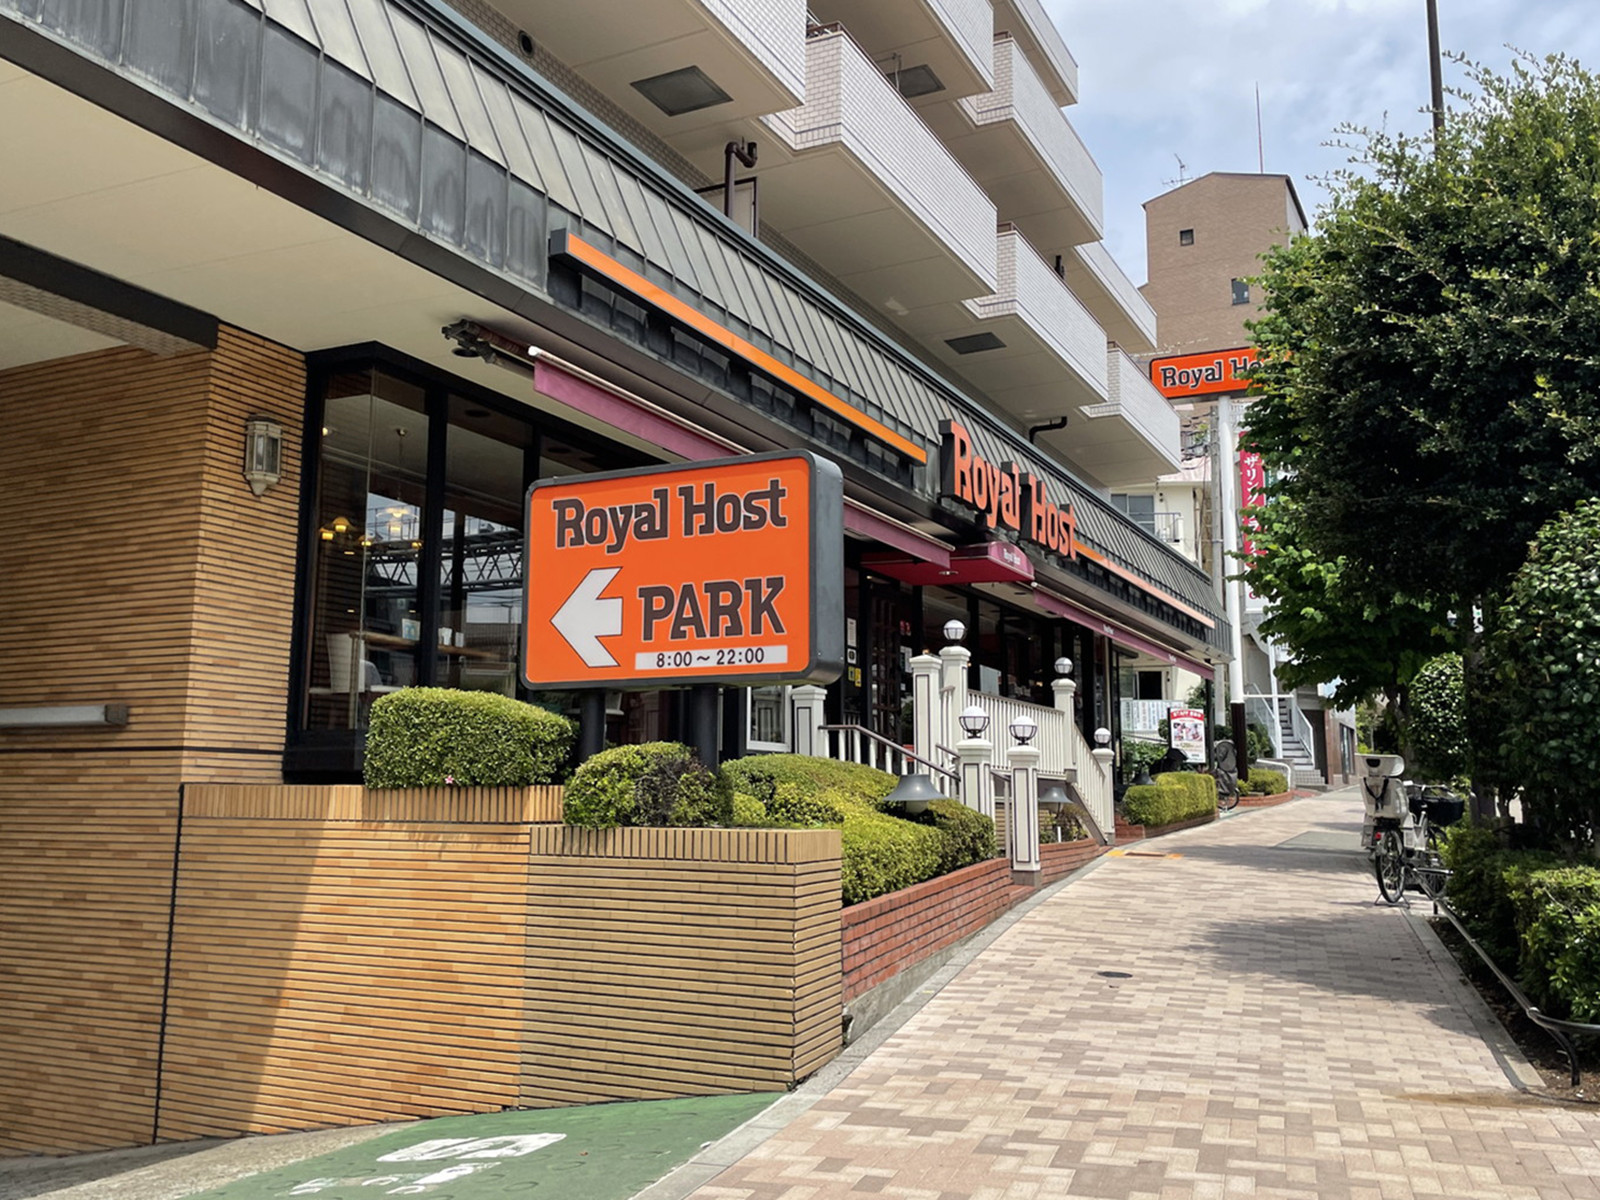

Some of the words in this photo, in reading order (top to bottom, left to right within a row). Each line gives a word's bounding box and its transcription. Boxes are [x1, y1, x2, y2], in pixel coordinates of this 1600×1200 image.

[1160, 360, 1223, 389] Royal
[552, 487, 669, 554] Royal
[678, 478, 788, 537] Host
[951, 420, 1021, 532] Royal
[1028, 473, 1077, 561] Host
[637, 576, 786, 642] PARK
